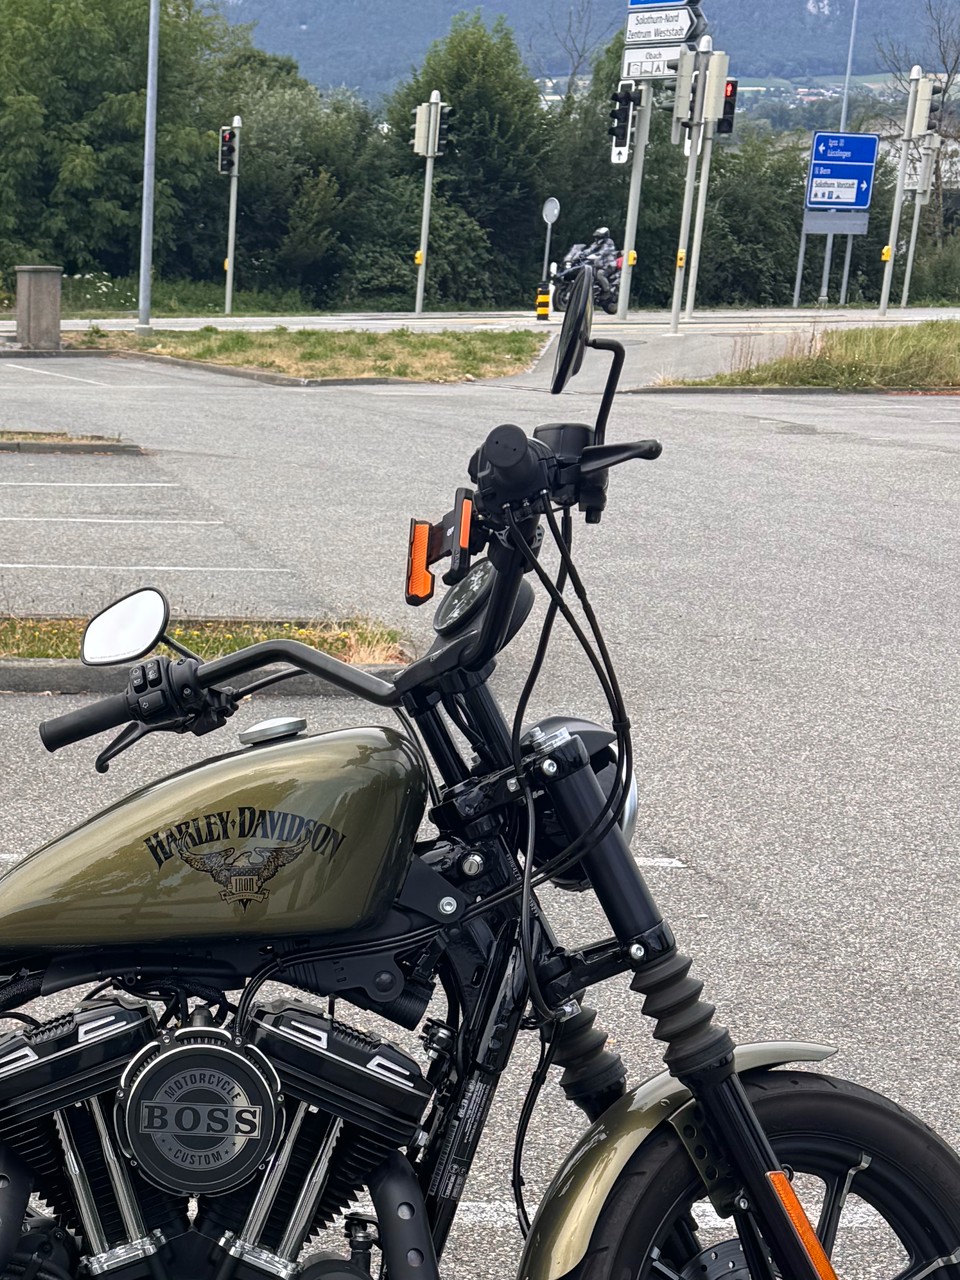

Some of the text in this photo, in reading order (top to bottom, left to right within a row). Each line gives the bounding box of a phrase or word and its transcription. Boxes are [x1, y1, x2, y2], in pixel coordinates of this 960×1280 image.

[627, 26, 684, 39] Zentrum Weststadt
[164, 1072, 241, 1102] MOTORCYCLE
[144, 1105, 257, 1135] BOSS
[173, 1149, 223, 1166] CUSTOM
